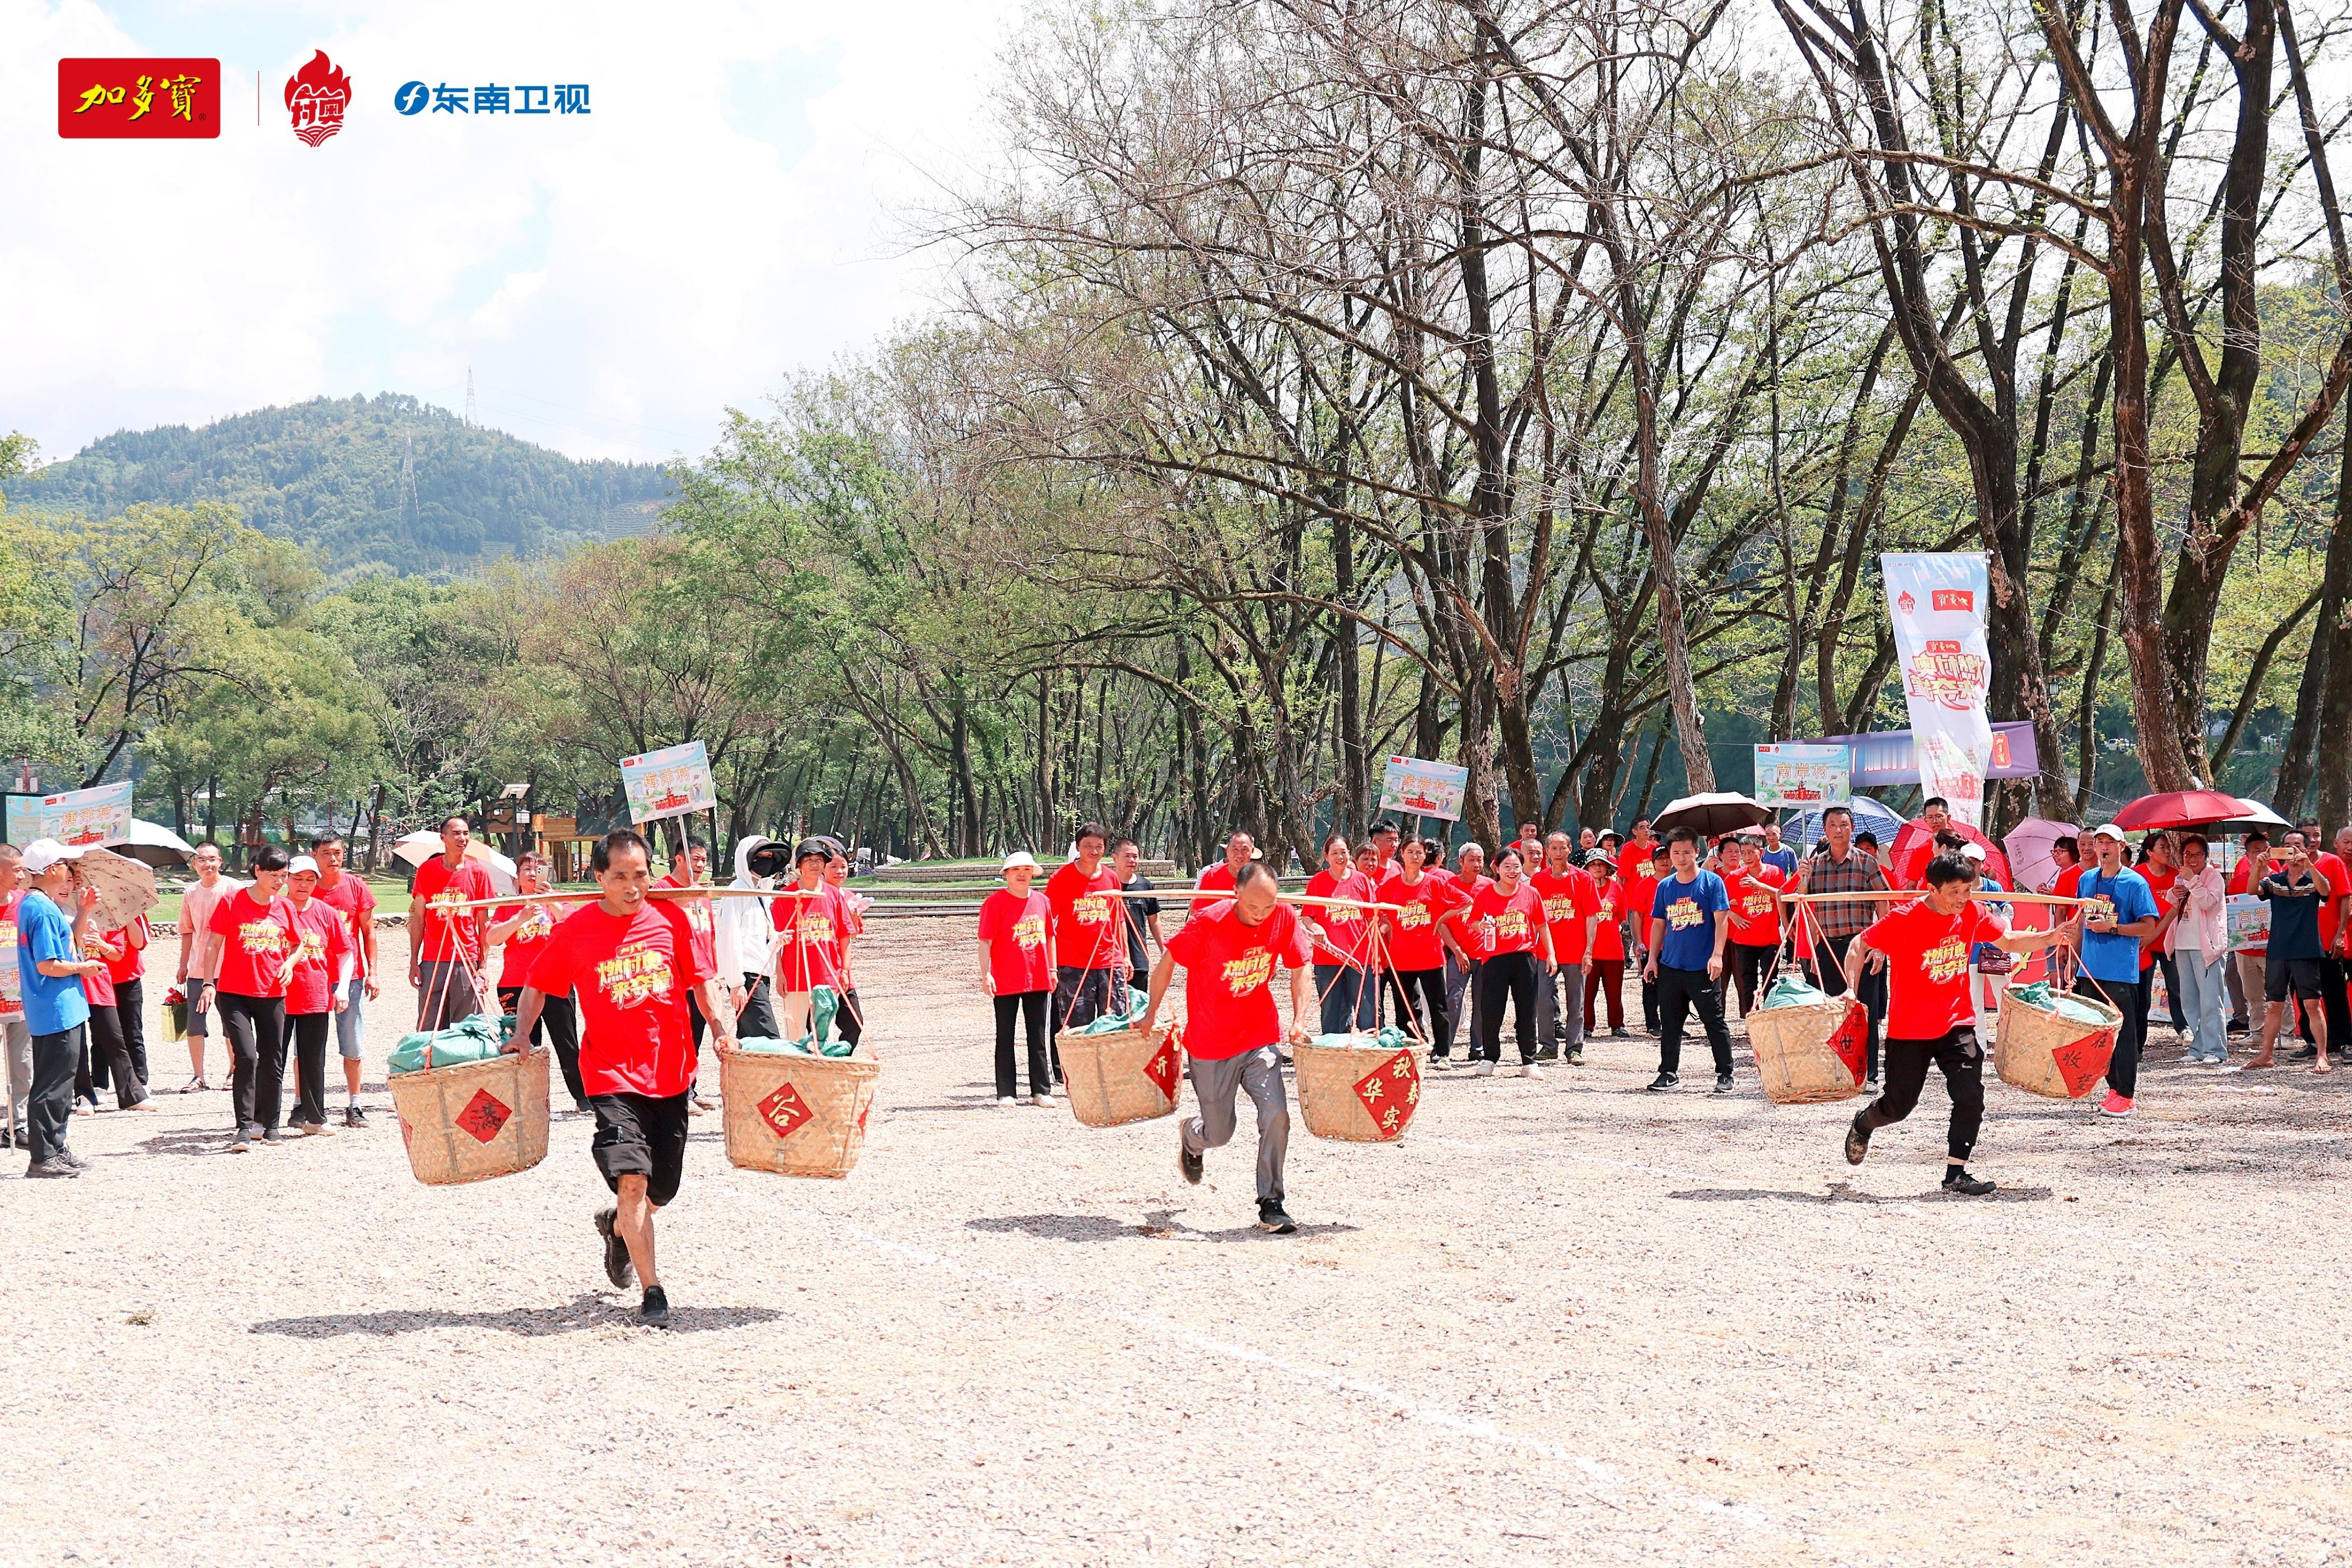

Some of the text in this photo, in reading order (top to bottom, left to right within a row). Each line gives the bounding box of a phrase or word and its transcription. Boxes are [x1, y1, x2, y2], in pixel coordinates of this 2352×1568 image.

[642, 764, 690, 790] 梅洋村
[1402, 774, 1448, 794] 象岩村
[1776, 762, 1829, 780] 南岸村
[62, 804, 113, 827] 塘洋村
[1920, 940, 1967, 970] 燃村奥
[595, 950, 663, 993] 燃村奥
[1393, 1056, 1412, 1079] 秋
[1362, 1077, 1385, 1104] 华
[1405, 1080, 1420, 1105] 春
[768, 1094, 801, 1127] 谷
[1382, 1105, 1401, 1132] 实
